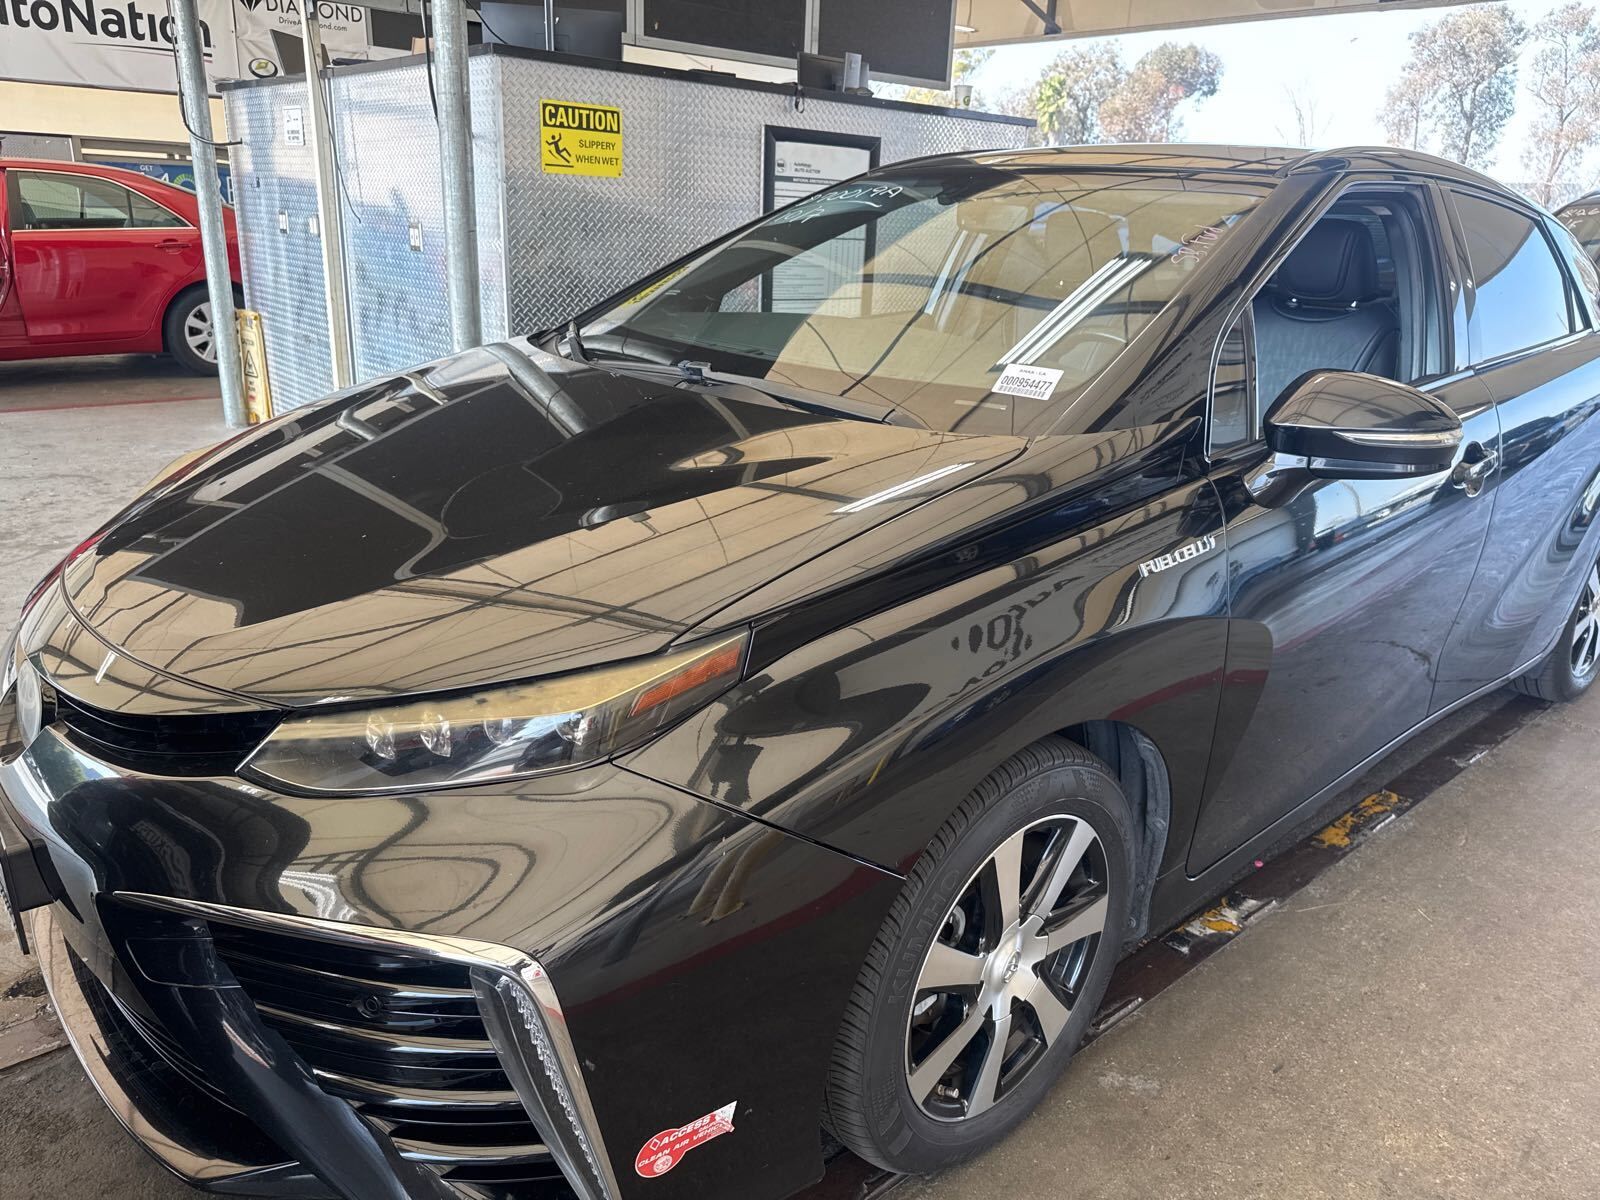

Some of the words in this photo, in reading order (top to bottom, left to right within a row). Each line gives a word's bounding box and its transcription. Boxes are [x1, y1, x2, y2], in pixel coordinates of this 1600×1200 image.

[266, 0, 363, 23] DIAOND
[545, 105, 618, 131] CAUTION
[579, 140, 616, 151] SLIPPERY
[575, 154, 601, 164] WHEN
[601, 157, 620, 167] WET
[1000, 375, 1054, 392] 000954477
[660, 1115, 710, 1146] ACCESS
[638, 1148, 670, 1167] CLEAN
[673, 1139, 689, 1151] AIR
